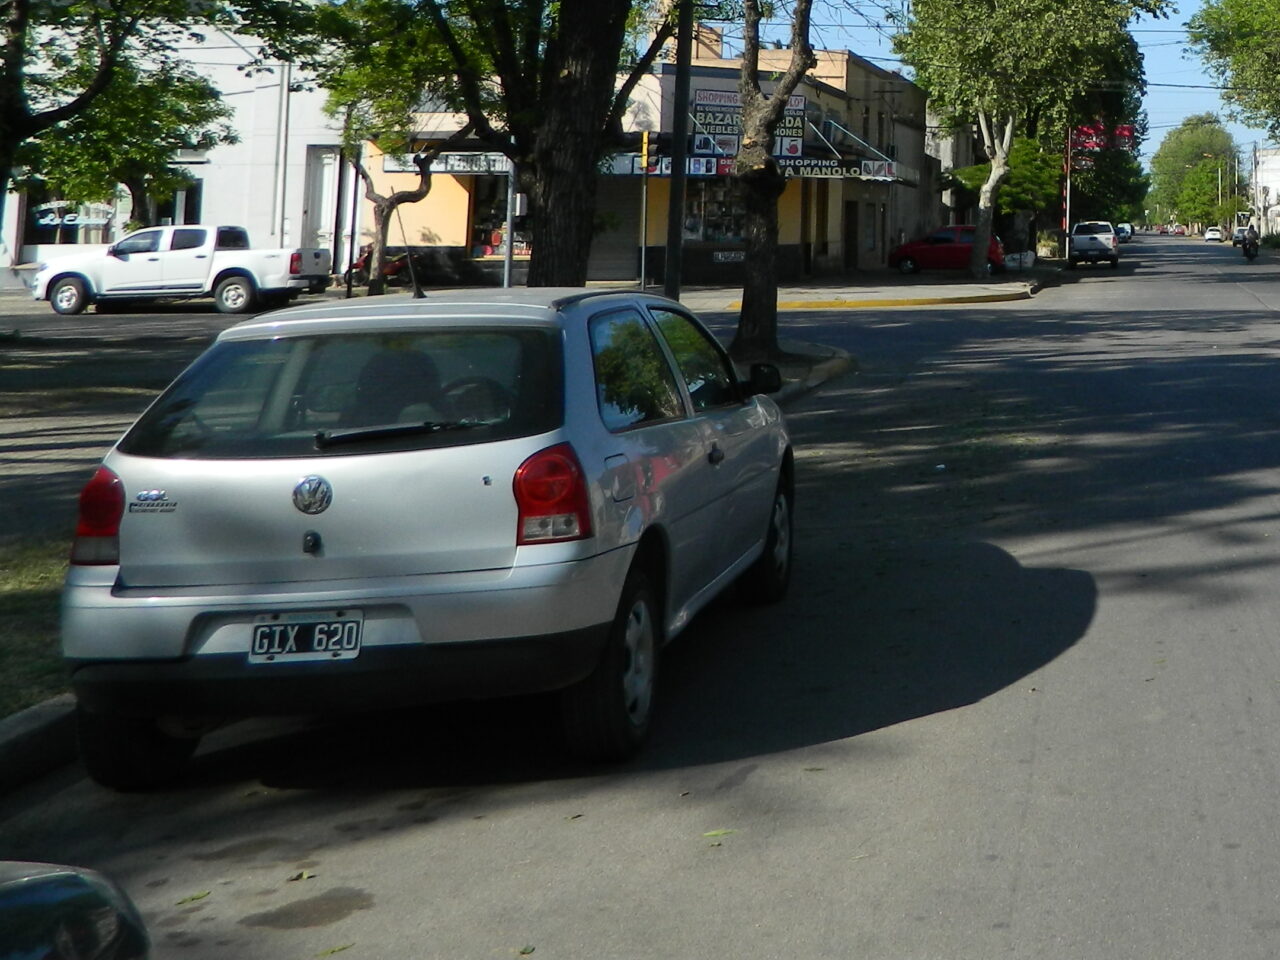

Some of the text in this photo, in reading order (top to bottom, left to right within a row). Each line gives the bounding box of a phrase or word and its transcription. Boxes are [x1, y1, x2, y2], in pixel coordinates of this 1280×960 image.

[697, 91, 738, 104] SHOPPING
[696, 112, 741, 126] BAZAR
[779, 159, 839, 167] SHOPPING
[799, 167, 860, 176] MANOLO
[254, 622, 357, 654] GIX 620
